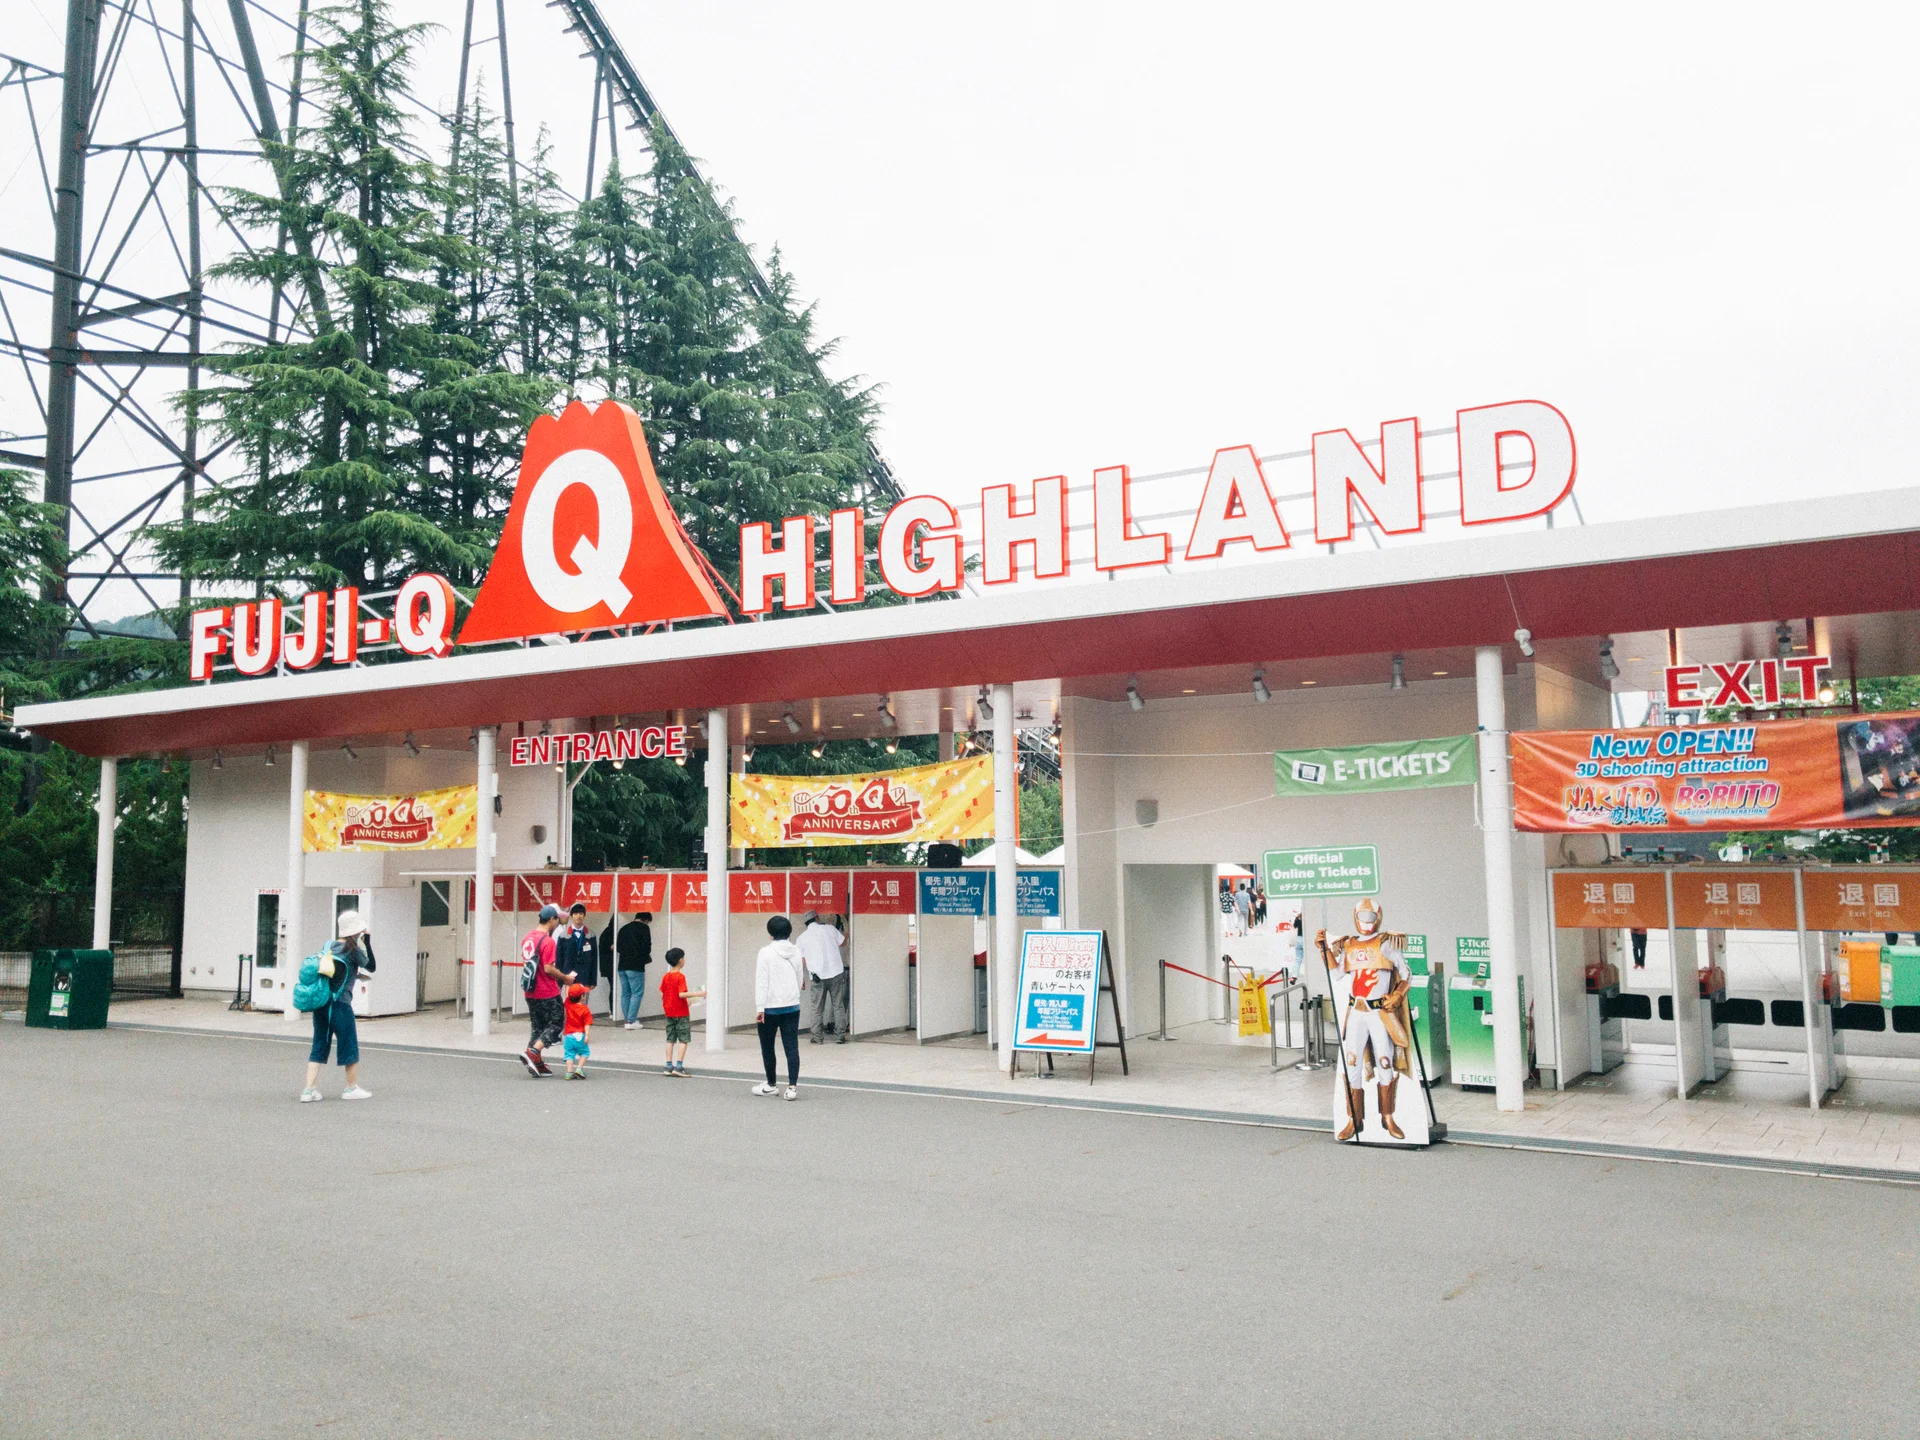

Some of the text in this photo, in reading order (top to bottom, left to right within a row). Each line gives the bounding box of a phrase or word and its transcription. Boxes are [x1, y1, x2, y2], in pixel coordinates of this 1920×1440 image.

[190, 399, 1578, 680] FUJI-Q Q HIGHLAND
[1663, 656, 1832, 709] EXIT
[510, 726, 687, 767] ENTRANCE
[1590, 727, 1757, 759] New OPEN!!
[1333, 751, 1451, 781] E-TICKETS
[1575, 755, 1768, 779] 3D shooting attraction
[1564, 785, 1658, 810] NARUTO
[803, 818, 898, 829] ANNIVERSARY
[353, 829, 419, 839] ANNIVERSARY
[1294, 852, 1343, 865] Official
[1271, 866, 1371, 879] Online Tickets
[576, 882, 602, 897] 入園
[630, 882, 655, 897] 入園
[744, 881, 773, 897] 入園
[803, 881, 833, 897] 入園
[869, 881, 900, 897] 入園
[1317, 881, 1349, 889] E-tickets
[1705, 882, 1761, 904] 退園
[1583, 883, 1635, 904] 退園
[1838, 883, 1900, 906] 退園
[1460, 948, 1479, 956] SCAN
[1055, 970, 1092, 980] のお客様
